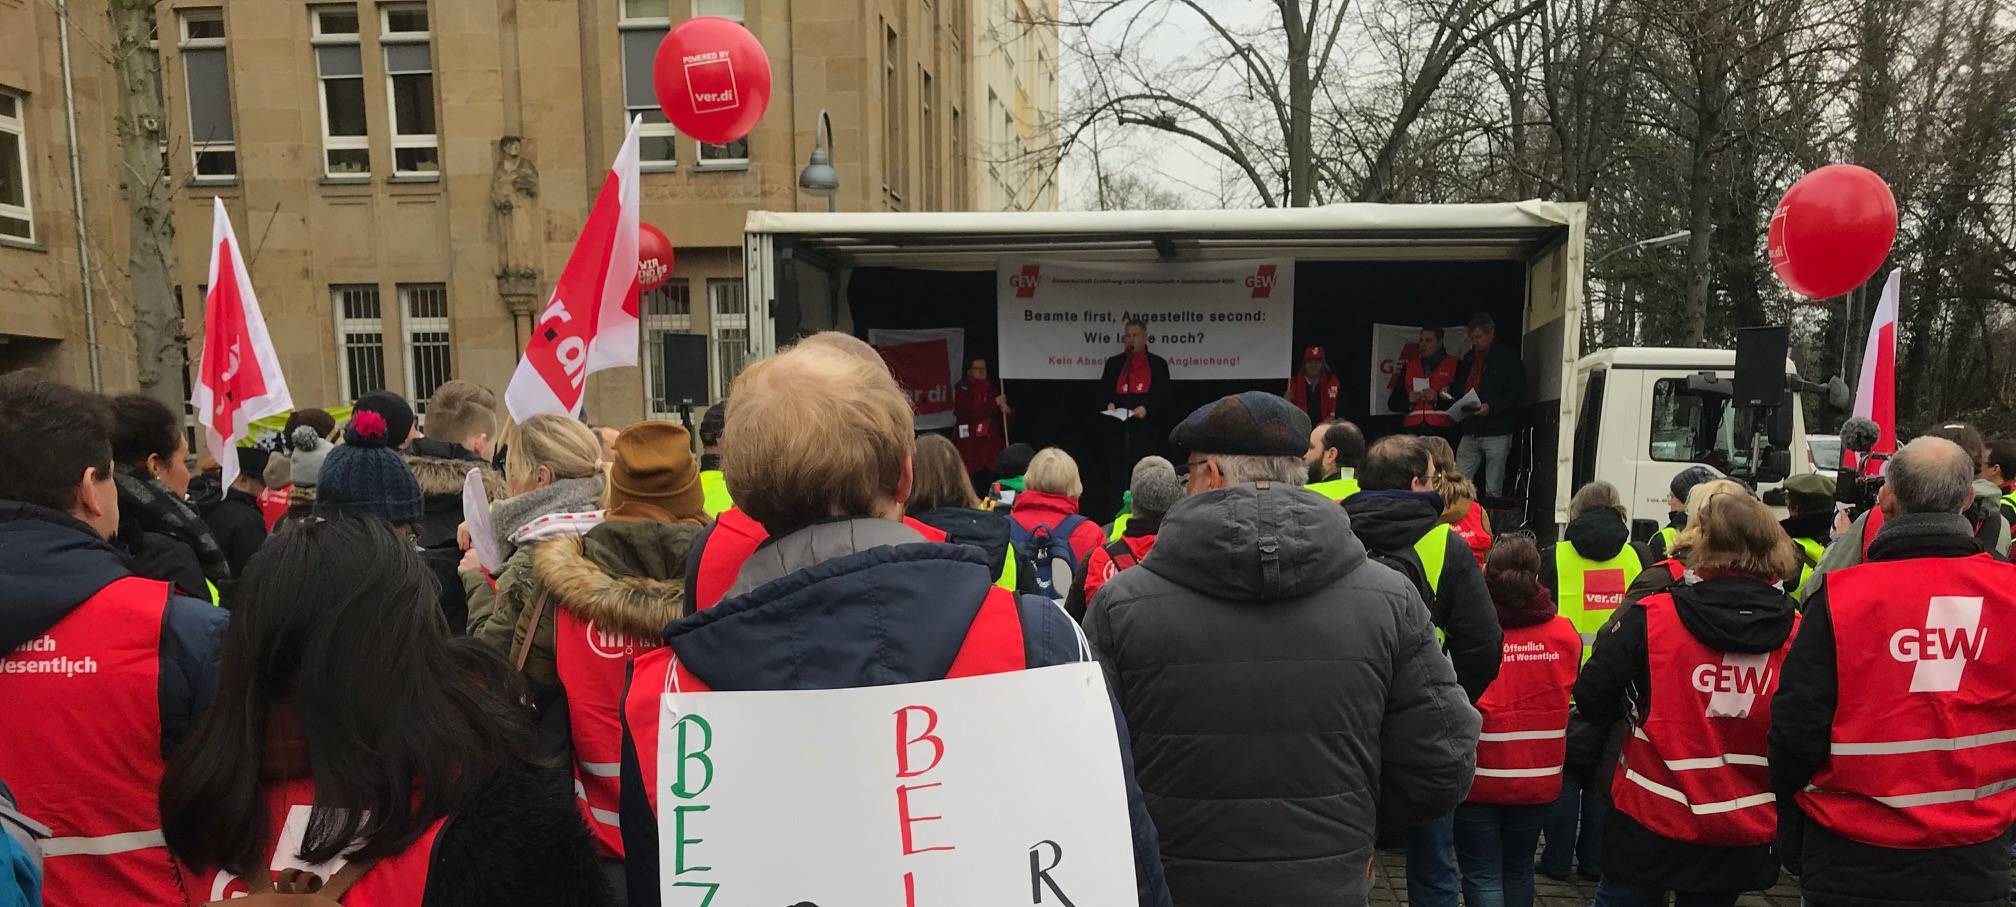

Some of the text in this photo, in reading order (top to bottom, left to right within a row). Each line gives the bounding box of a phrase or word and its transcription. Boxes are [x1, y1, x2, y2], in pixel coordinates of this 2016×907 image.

[719, 51, 729, 59] BY
[695, 90, 733, 102] ver.di
[639, 258, 658, 269] WIR
[1009, 275, 1041, 288] GEW
[1246, 275, 1277, 288] GEW
[1024, 310, 1266, 324] Beamte first, Angestellte second:
[1084, 332, 1205, 344] Wie lae noch?
[1048, 356, 1073, 366] Kein
[1168, 356, 1240, 367] Angleichung!
[1586, 593, 1623, 604] ver.di
[1889, 627, 1987, 662] GEW
[1503, 653, 1515, 662] ist
[1691, 664, 1773, 696] GEW
